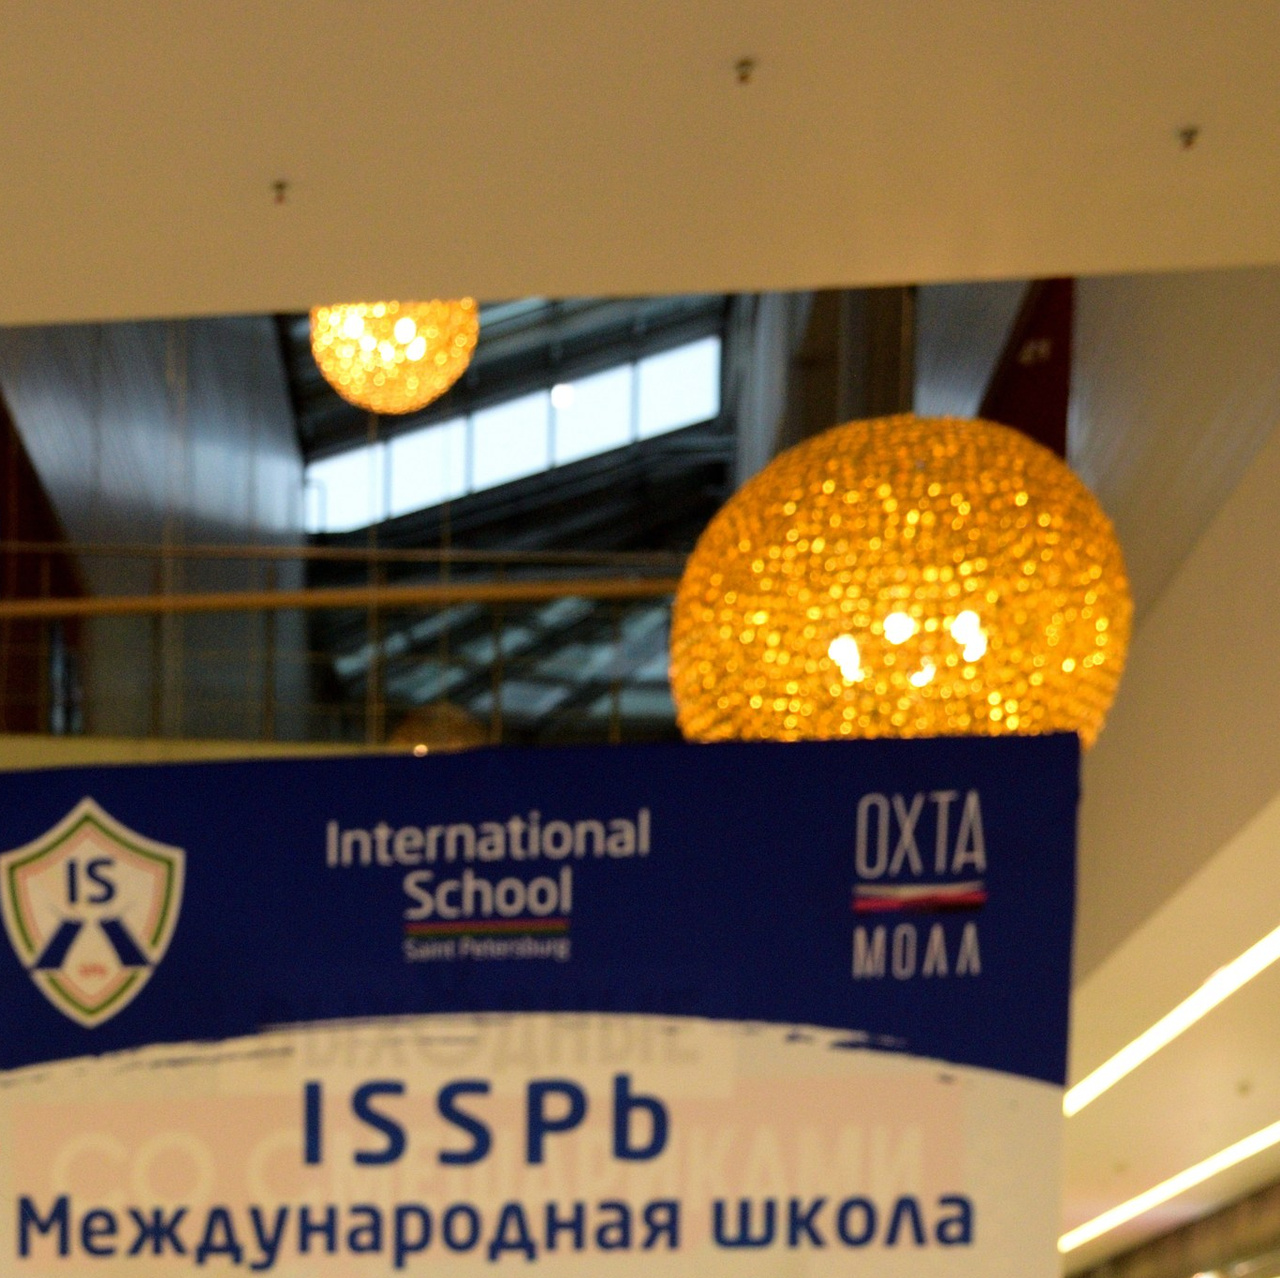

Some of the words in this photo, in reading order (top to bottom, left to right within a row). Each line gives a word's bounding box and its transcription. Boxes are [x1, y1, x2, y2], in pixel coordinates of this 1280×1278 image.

[325, 807, 652, 867] International
[854, 789, 988, 879] ОХТА
[66, 858, 115, 904] IS
[402, 865, 573, 920] School
[403, 937, 455, 961] Saint
[458, 935, 572, 963] Petersburg
[303, 1074, 670, 1166] ISSPb
[17, 1194, 681, 1271] Международная
[713, 1193, 976, 1249] школа
